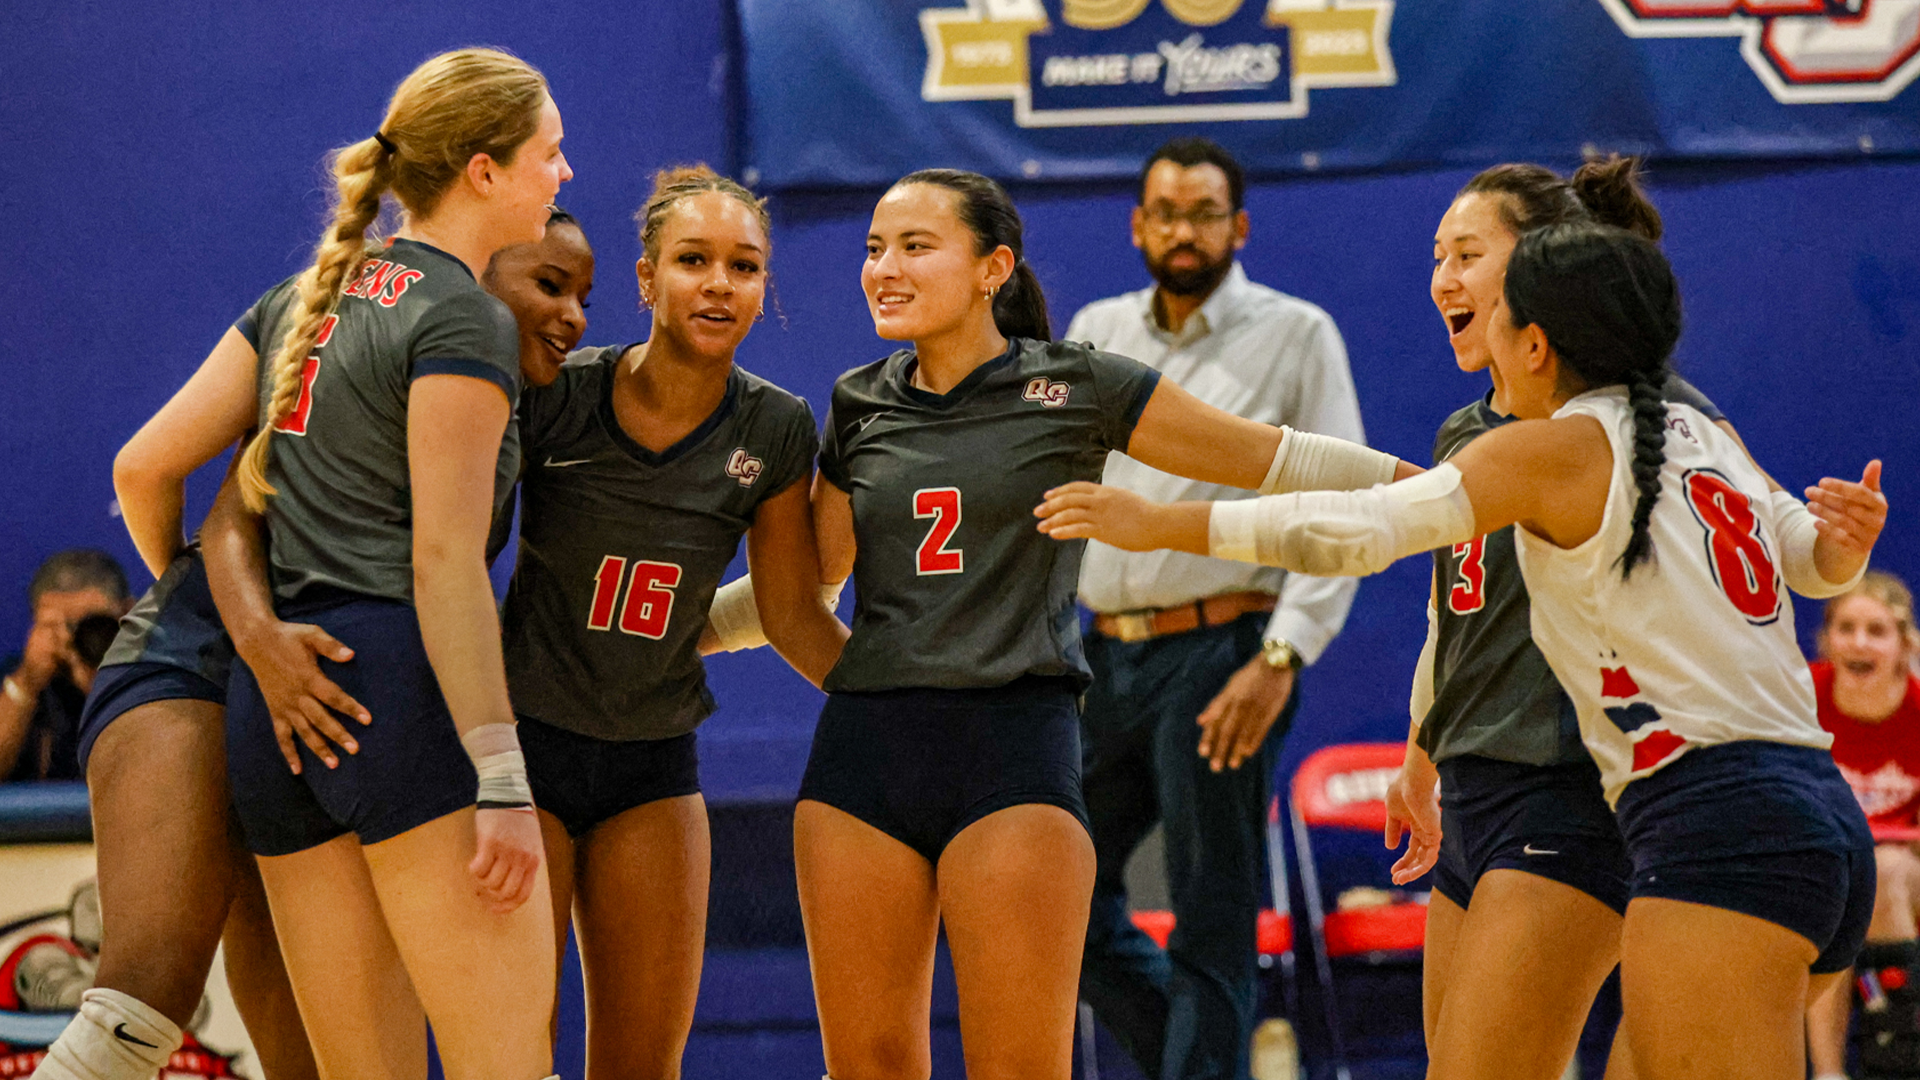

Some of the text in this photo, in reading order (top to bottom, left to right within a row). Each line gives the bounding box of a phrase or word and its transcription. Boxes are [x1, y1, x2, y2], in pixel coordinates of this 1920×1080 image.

[1043, 54, 1129, 87] MAKE
[1131, 53, 1163, 83] IT
[1021, 376, 1071, 408] QC
[725, 447, 763, 489] QC
[912, 487, 964, 576] 2
[1681, 467, 1782, 626] 8
[587, 554, 683, 640] 16
[1448, 532, 1487, 616] 3
